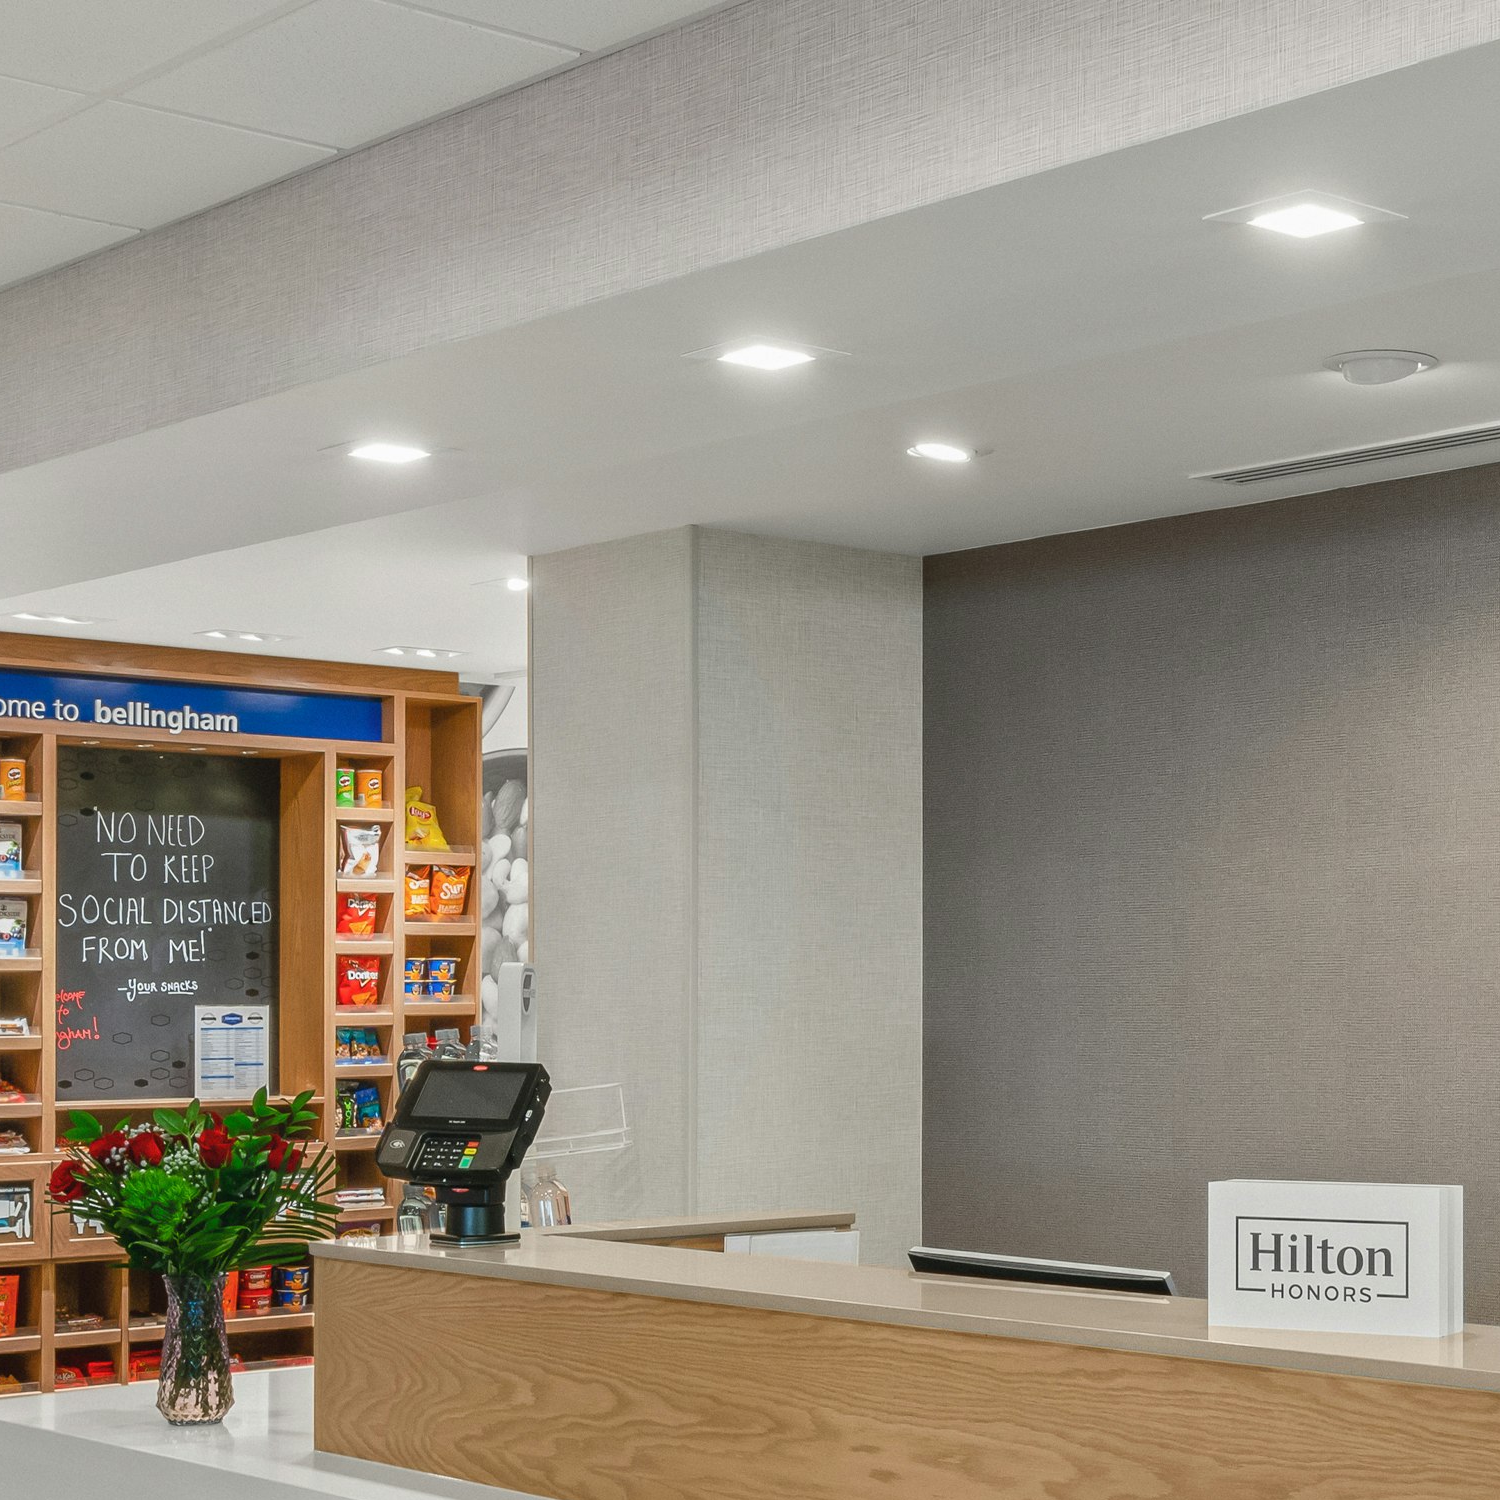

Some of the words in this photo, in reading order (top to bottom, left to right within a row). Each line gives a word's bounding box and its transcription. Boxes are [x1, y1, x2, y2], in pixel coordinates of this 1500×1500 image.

[52, 699, 80, 722] to
[93, 698, 239, 735] bellingham
[96, 811, 137, 844] NO
[147, 814, 205, 847] NEED
[100, 852, 147, 883] TO
[163, 854, 215, 884] KEEP
[57, 893, 153, 927] SOCIAL
[163, 898, 272, 925] DISTANCED
[81, 936, 149, 964] FROM
[168, 929, 207, 964] ME!
[160, 979, 199, 994] SNACKS
[1249, 1231, 1395, 1278] Hilton
[1270, 1283, 1373, 1304] HONORS
